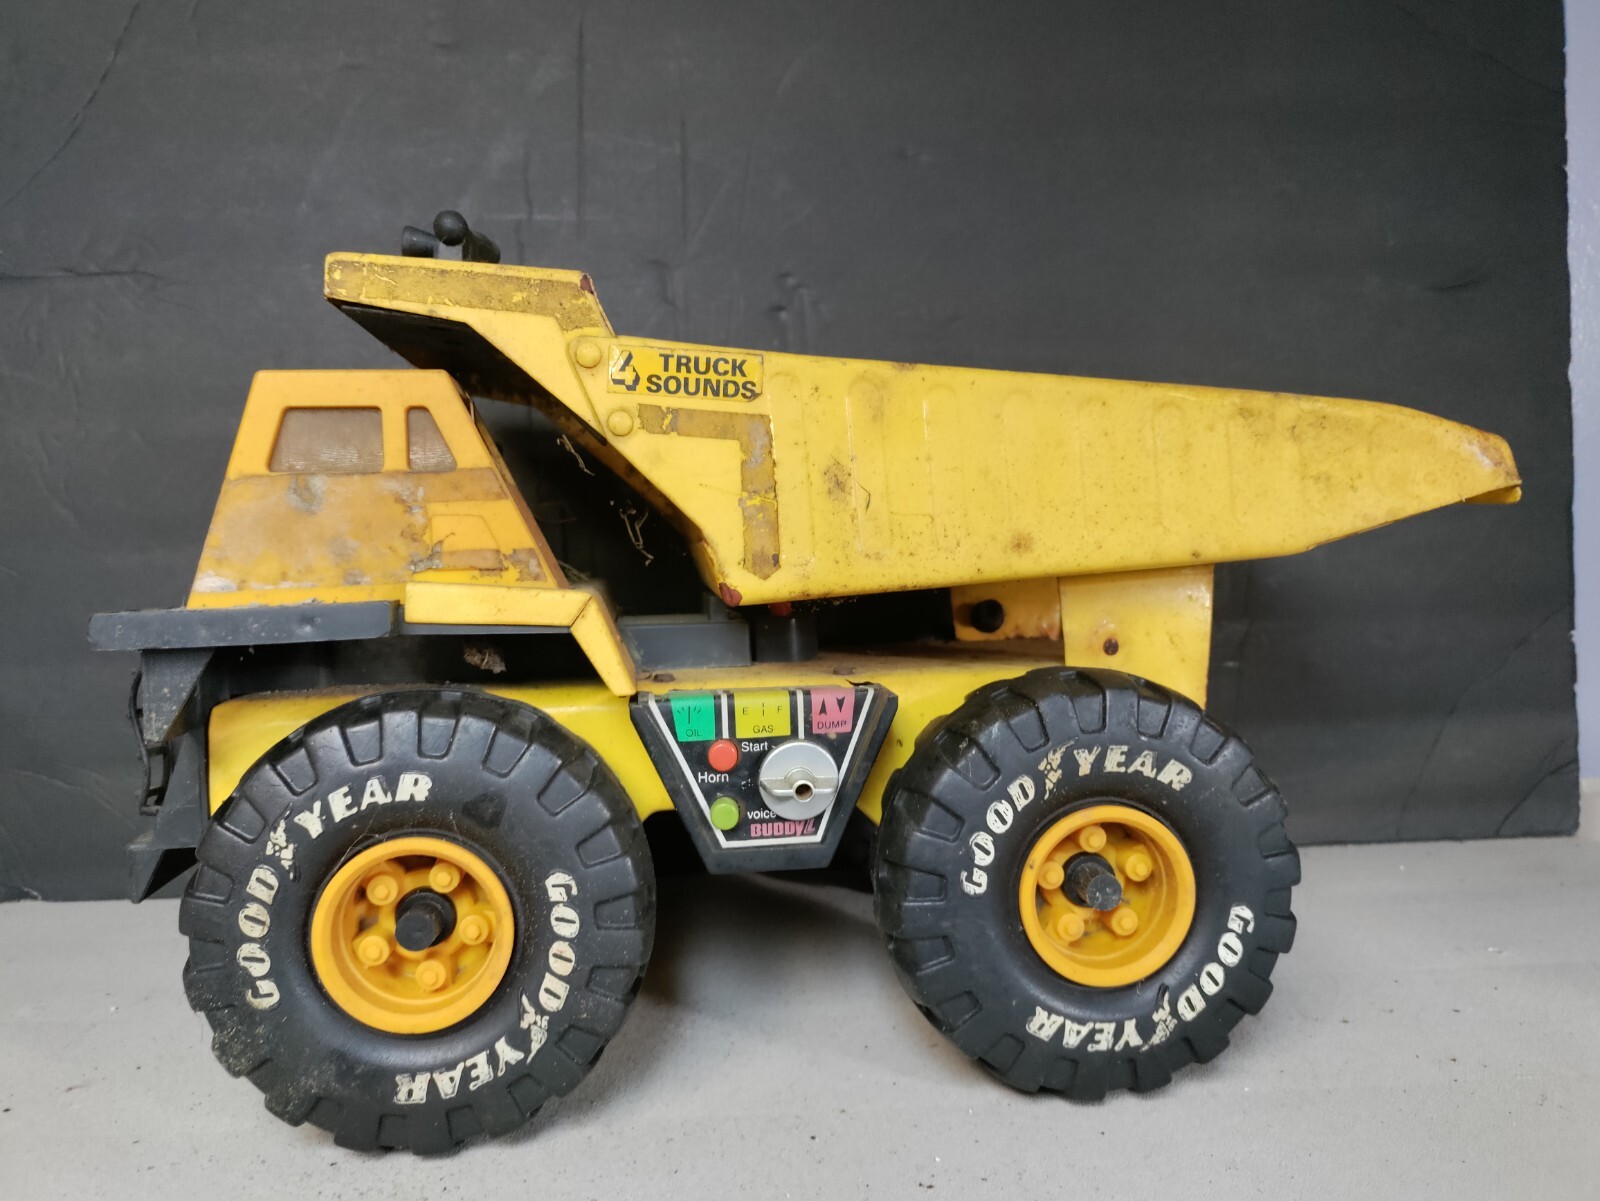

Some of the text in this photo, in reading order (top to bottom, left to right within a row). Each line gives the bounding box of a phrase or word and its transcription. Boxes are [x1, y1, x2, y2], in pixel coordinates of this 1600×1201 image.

[611, 350, 747, 391] 4 TRUCK
[646, 374, 757, 399] SOUNDS
[752, 724, 774, 733] GAS
[817, 720, 847, 730] DUMP
[685, 728, 702, 737] OIL
[741, 741, 768, 752] Start
[698, 772, 729, 783] Horn
[747, 808, 776, 819] voice
